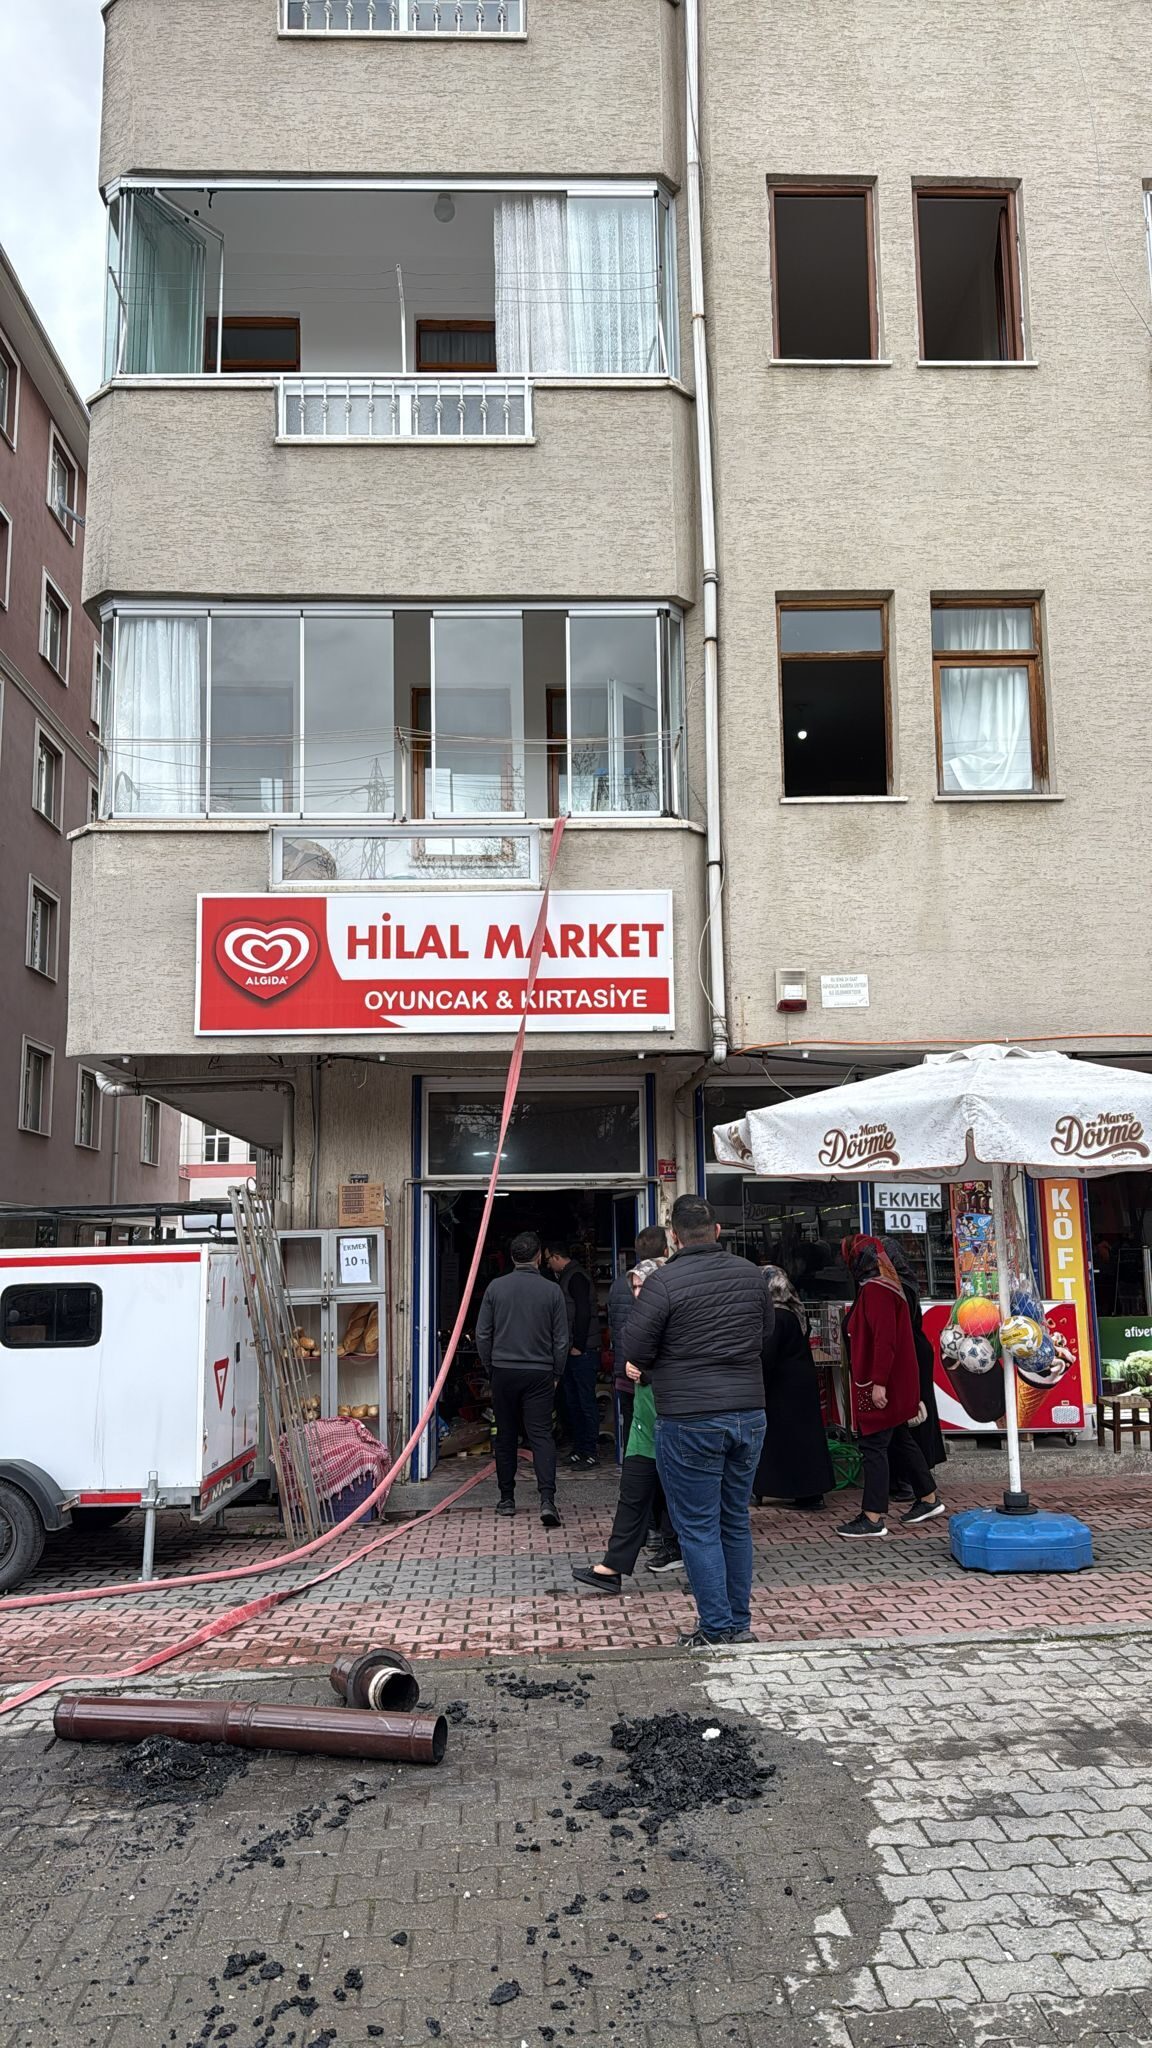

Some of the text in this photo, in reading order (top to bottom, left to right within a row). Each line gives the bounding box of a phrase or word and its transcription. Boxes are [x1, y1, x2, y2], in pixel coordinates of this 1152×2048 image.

[347, 911, 664, 960] HİLAL MARKET
[364, 984, 648, 1010] OYUNCAK & KIRTASİYE
[1098, 1112, 1135, 1126] Maraş
[1050, 1115, 1145, 1156] Dövme
[818, 1128, 897, 1167] Dövme
[878, 1191, 941, 1207] EKMEK
[890, 1213, 925, 1232] 10 TL
[343, 1243, 367, 1251] EKMEK
[344, 1256, 358, 1267] 10
